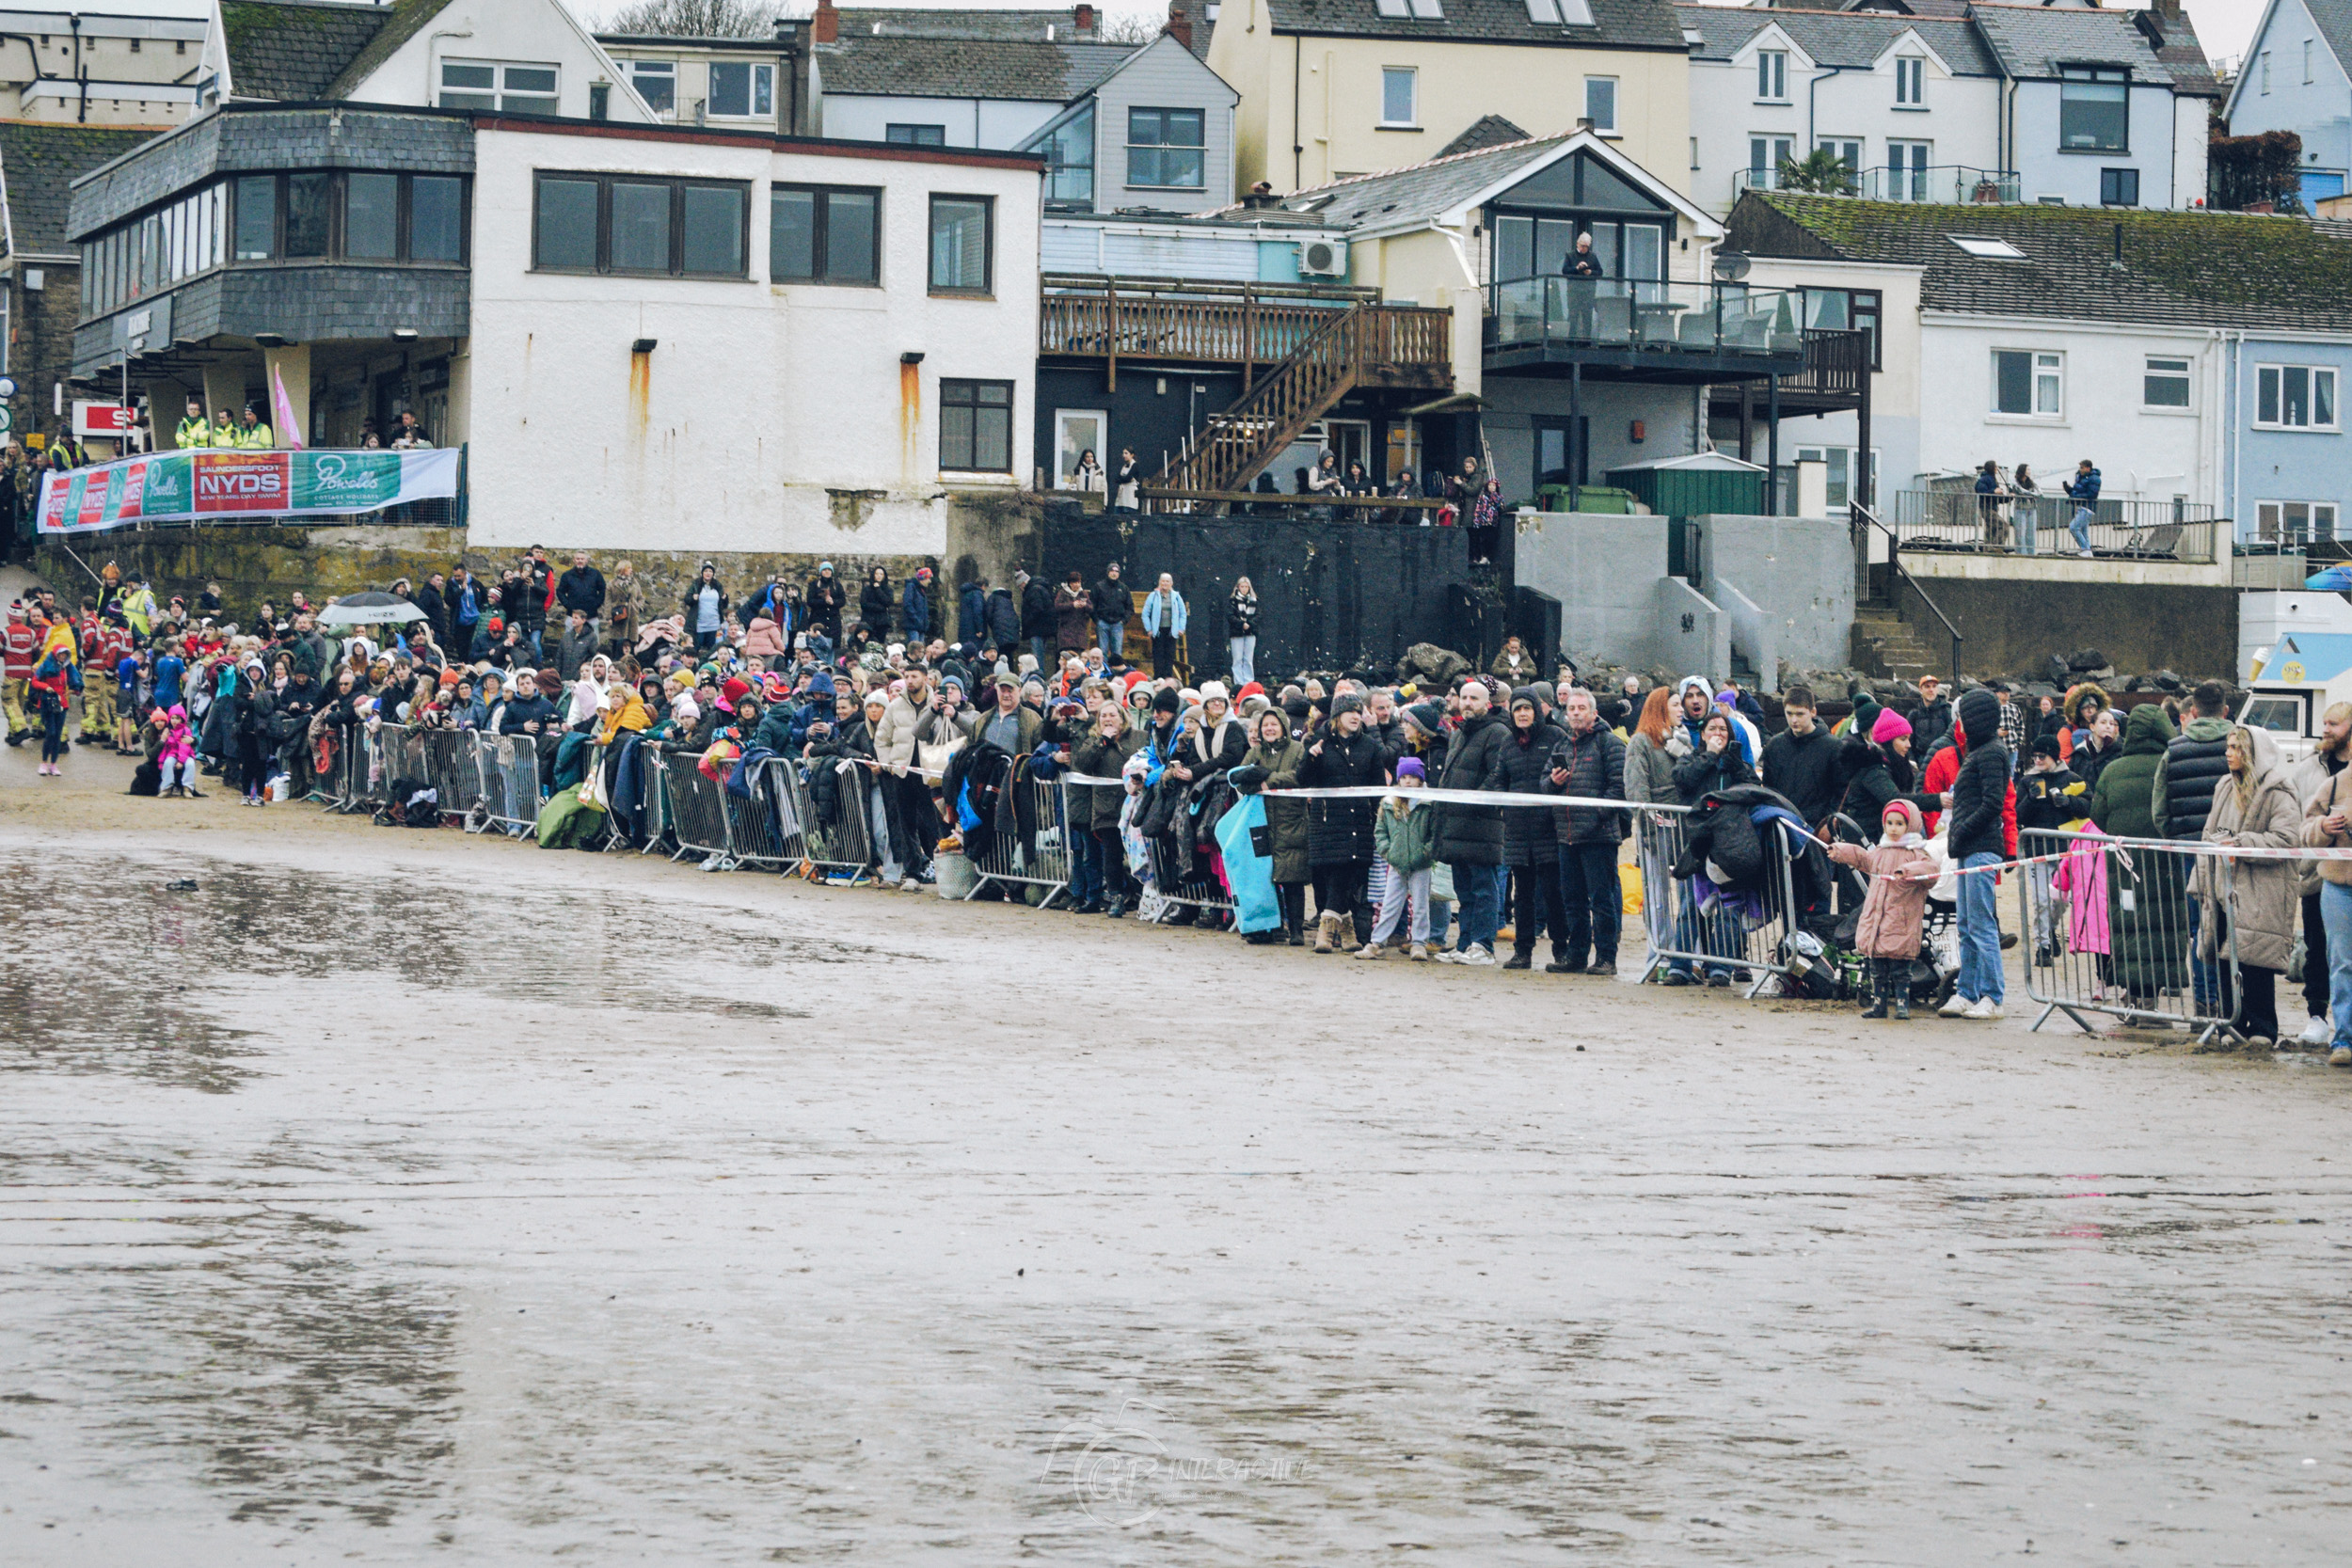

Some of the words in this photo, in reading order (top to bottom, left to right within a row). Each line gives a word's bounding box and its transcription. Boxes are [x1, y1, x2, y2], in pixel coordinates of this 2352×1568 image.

[149, 462, 179, 498] Powells
[199, 465, 280, 473] SAUNDERSFOOT
[314, 454, 379, 491] Powells
[199, 473, 281, 494] NYDS
